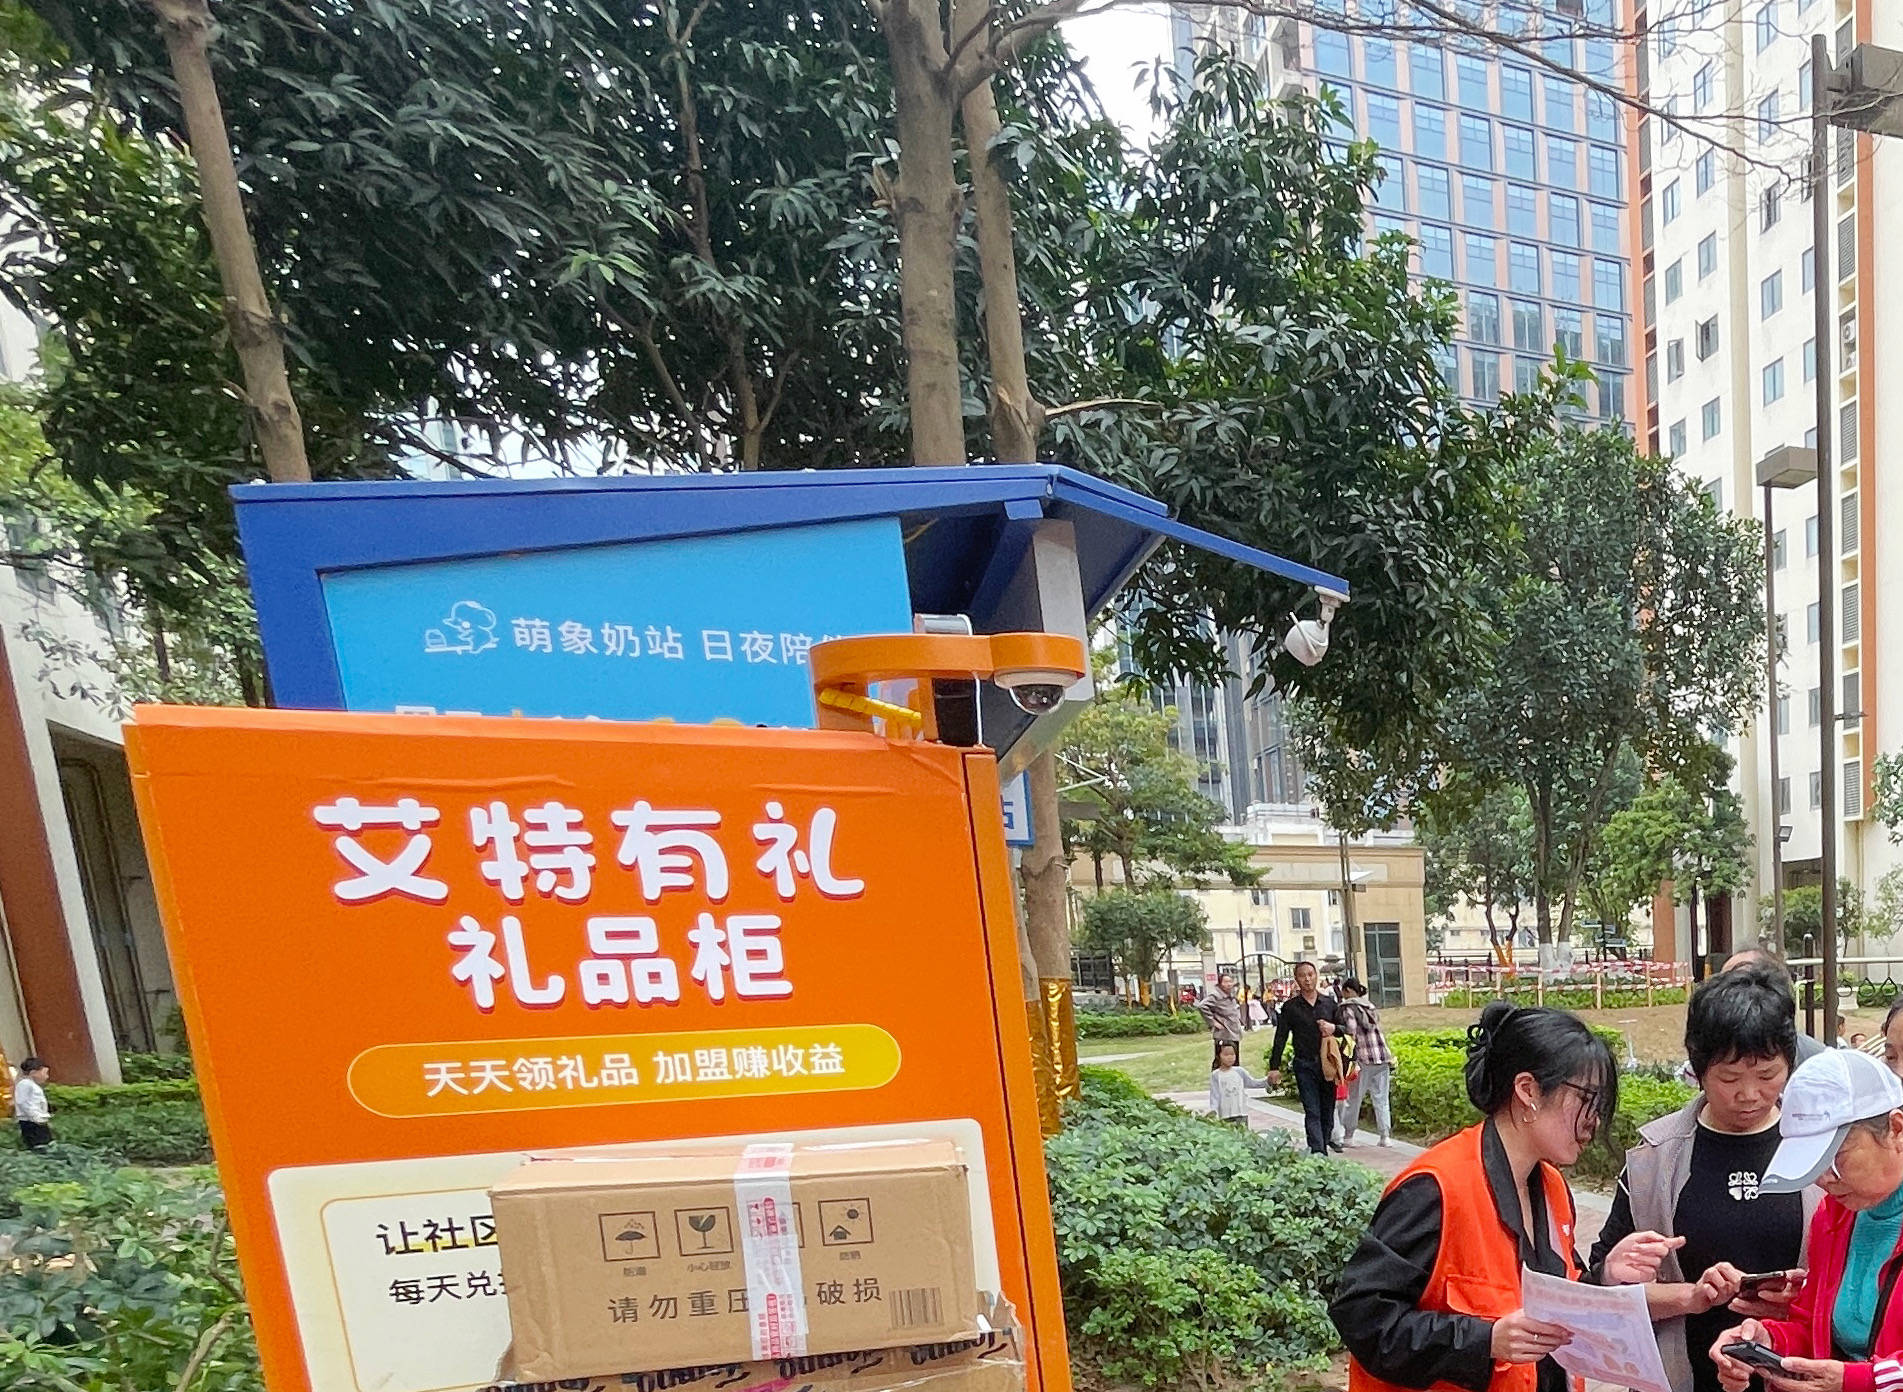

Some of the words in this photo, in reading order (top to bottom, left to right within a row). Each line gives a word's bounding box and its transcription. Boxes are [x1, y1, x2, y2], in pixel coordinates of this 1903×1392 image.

[511, 616, 685, 661] 萌象奶站
[701, 628, 848, 666] 日夜陪
[313, 797, 865, 901] 艾特有礼
[447, 912, 794, 1010] 礼品柜
[424, 1052, 640, 1098] 天天领礼品
[655, 1042, 846, 1086] 加盟赚收益
[375, 1215, 499, 1256] 让社区
[388, 1269, 508, 1305] 每天兑
[815, 1277, 883, 1307] 破损
